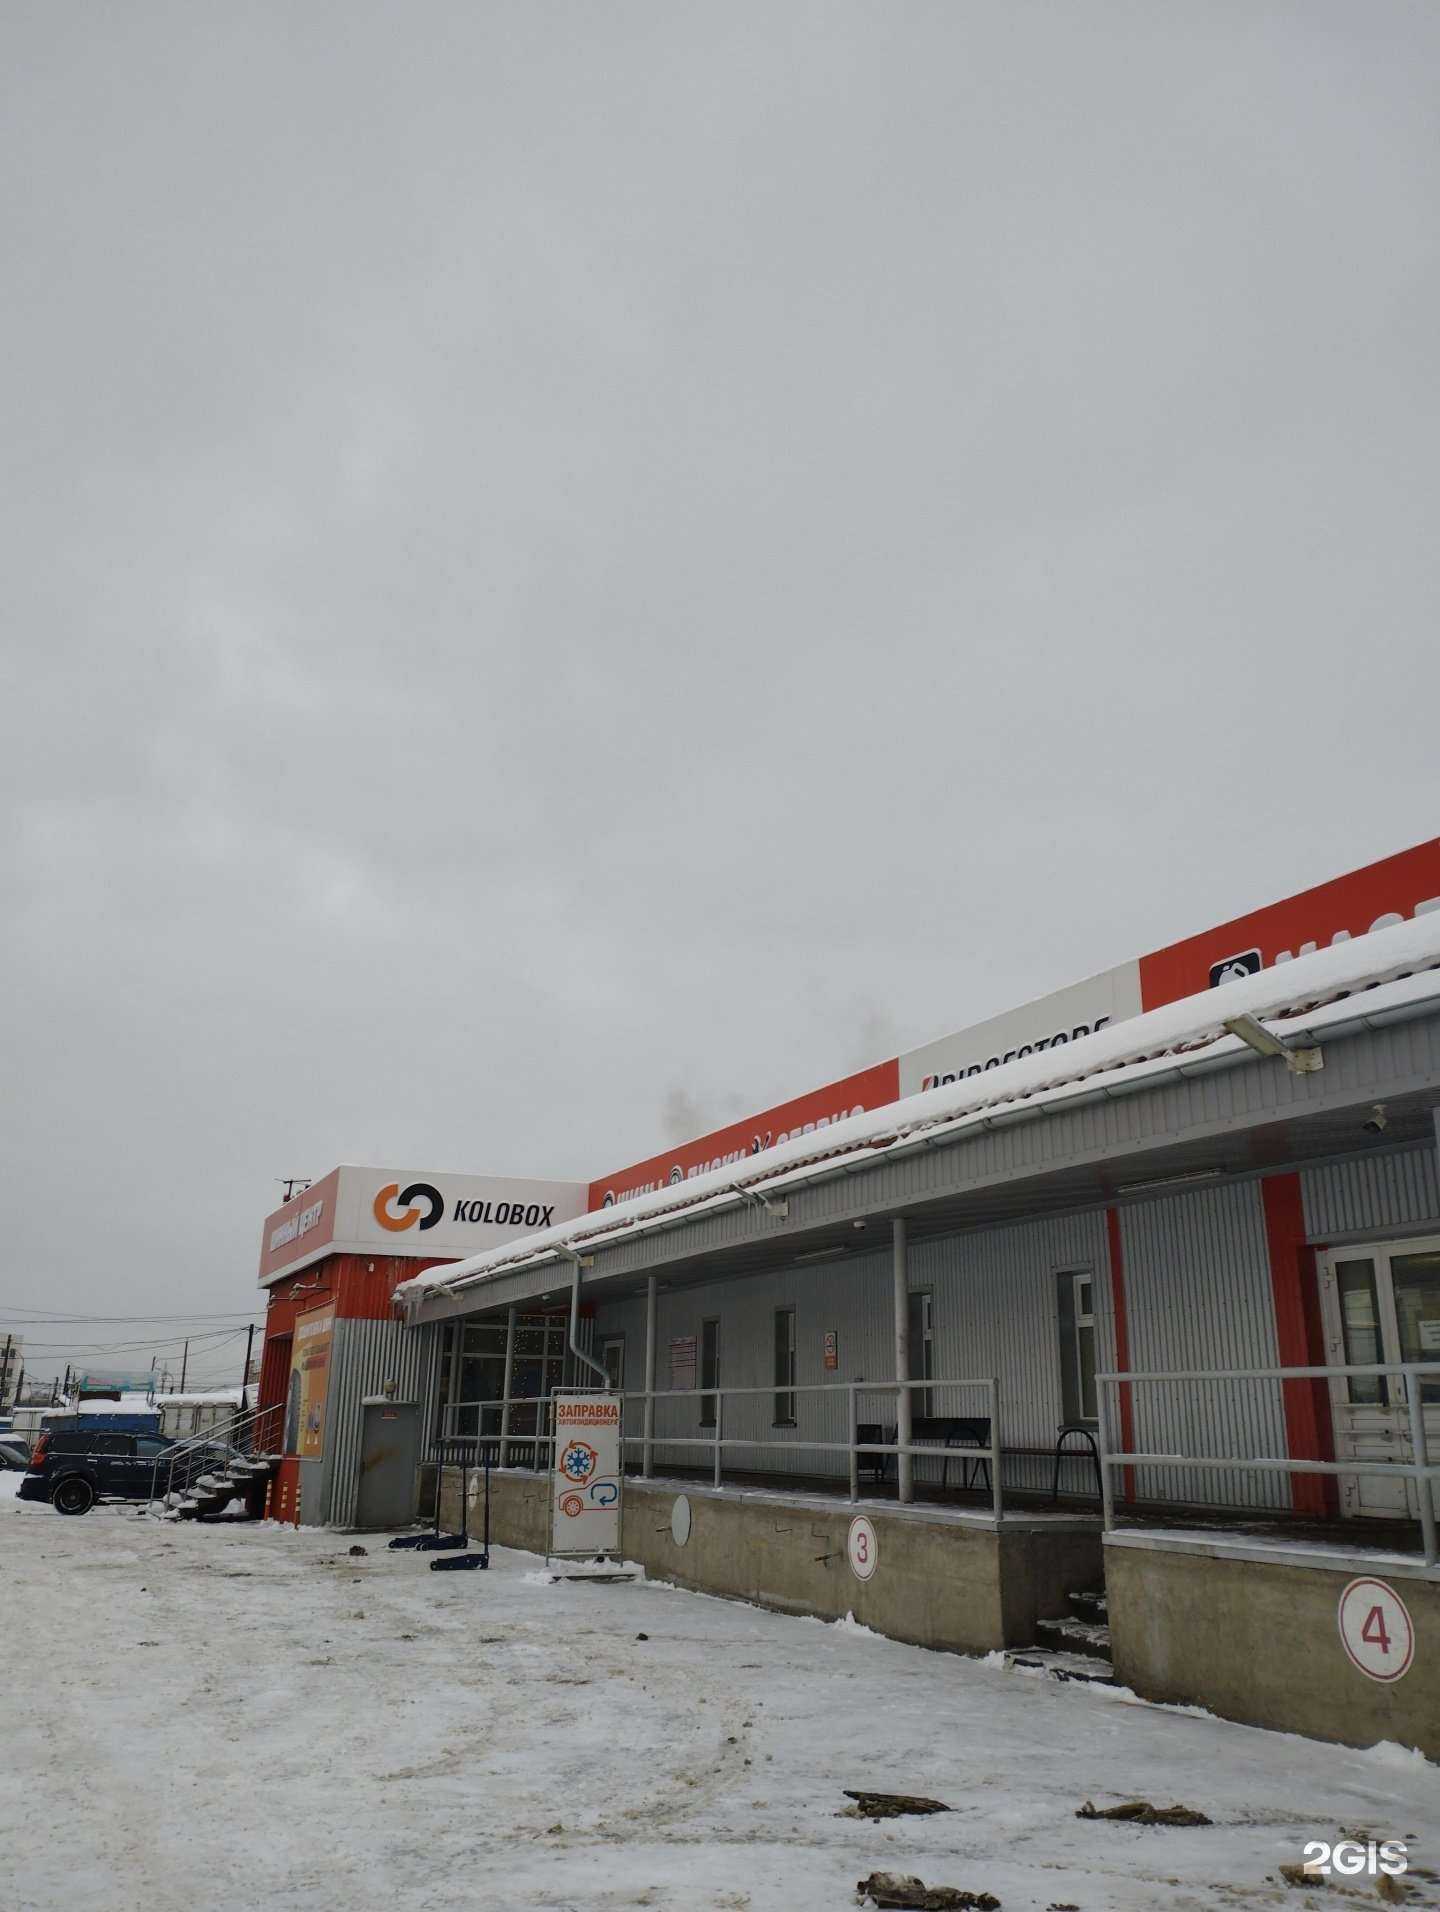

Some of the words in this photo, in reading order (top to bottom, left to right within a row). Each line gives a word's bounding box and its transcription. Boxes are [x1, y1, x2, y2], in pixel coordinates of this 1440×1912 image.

[453, 1200, 555, 1227] KOLOBOX
[559, 1404, 618, 1417] ЗАПРАВКА
[857, 1532, 868, 1563] 3
[1361, 1606, 1392, 1654] 4
